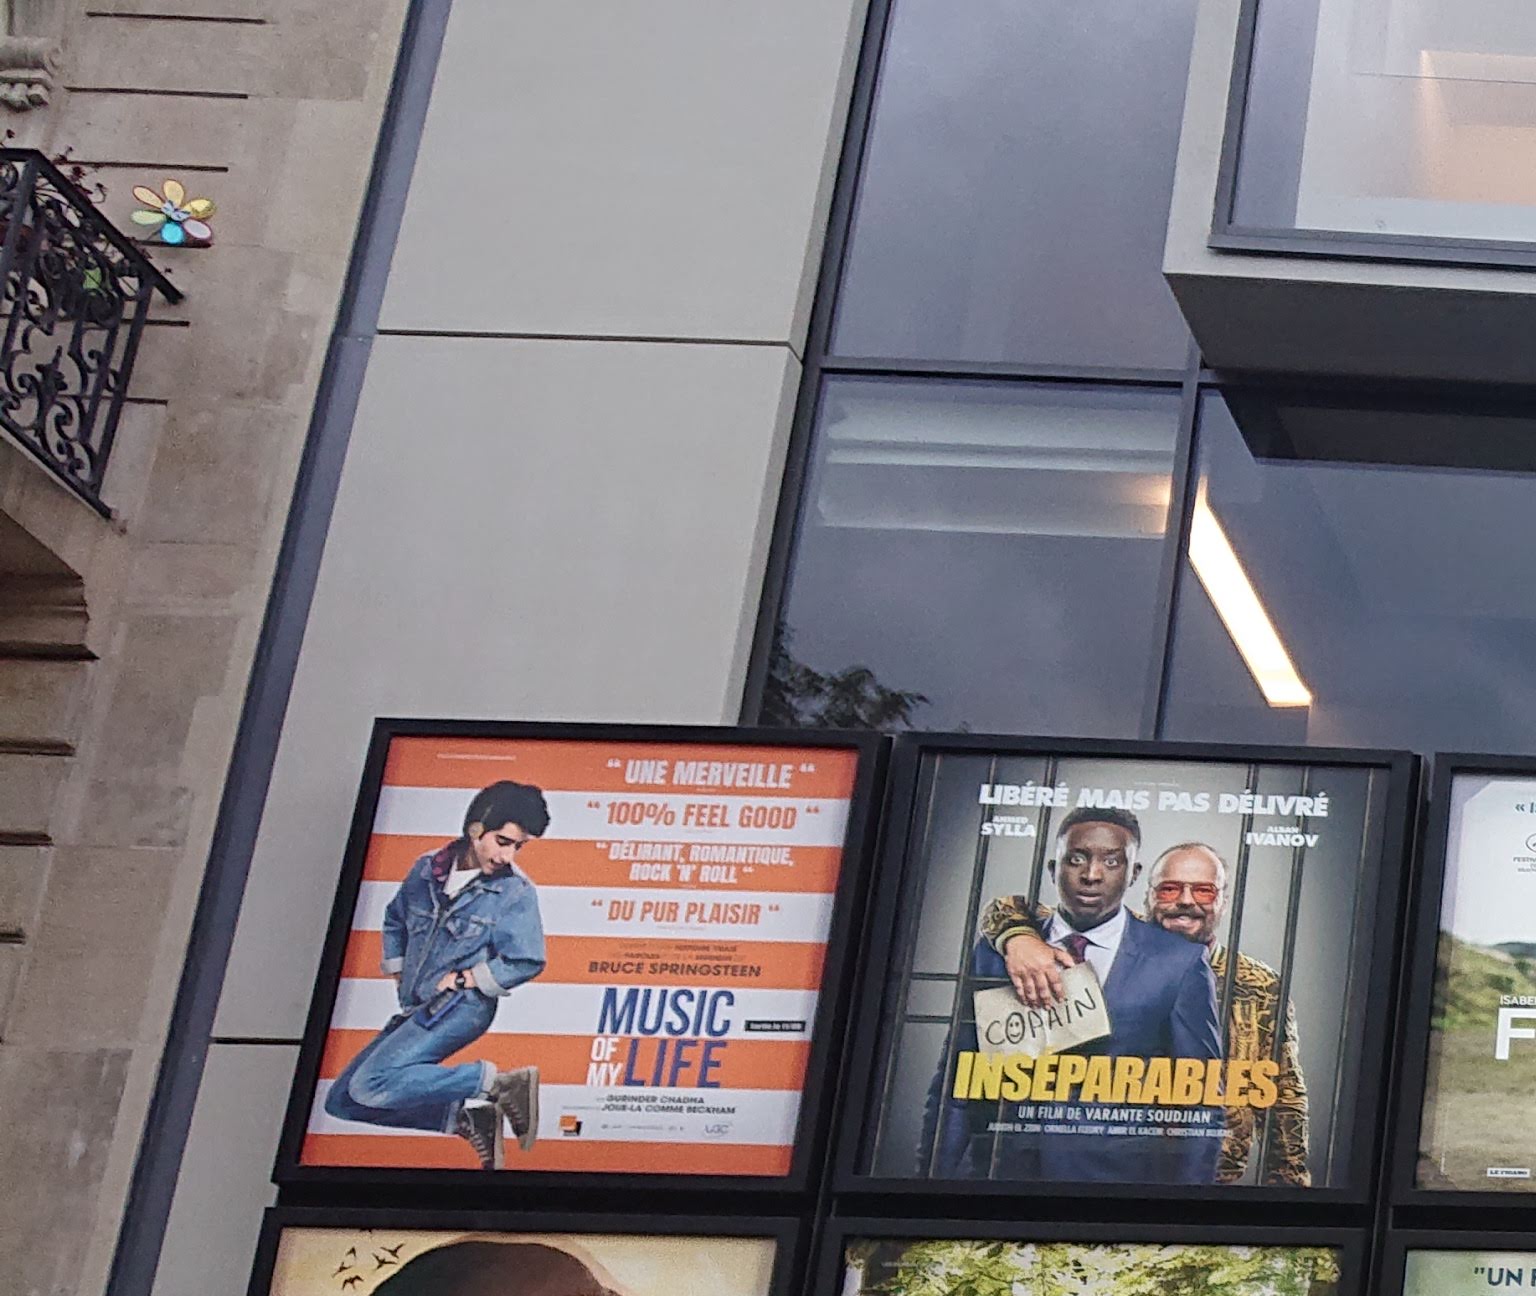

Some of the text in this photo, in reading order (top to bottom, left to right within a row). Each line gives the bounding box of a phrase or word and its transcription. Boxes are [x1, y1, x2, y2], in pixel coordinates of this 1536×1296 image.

[978, 780, 1329, 817] LIBÉRÉ MAIS PAS DÉLIVRÉ
[606, 801, 797, 830] 100% FEEL GOOD
[981, 822, 1035, 838] SYLLA
[1246, 832, 1319, 848] IVANOV
[607, 900, 761, 925] DU PUR PLAISIR
[588, 961, 761, 977] BRUCE SPRINGSTEEN
[597, 987, 735, 1037] MUSIC
[590, 1037, 620, 1062] OF
[586, 1062, 623, 1088] MY
[623, 1038, 728, 1088] LIFE
